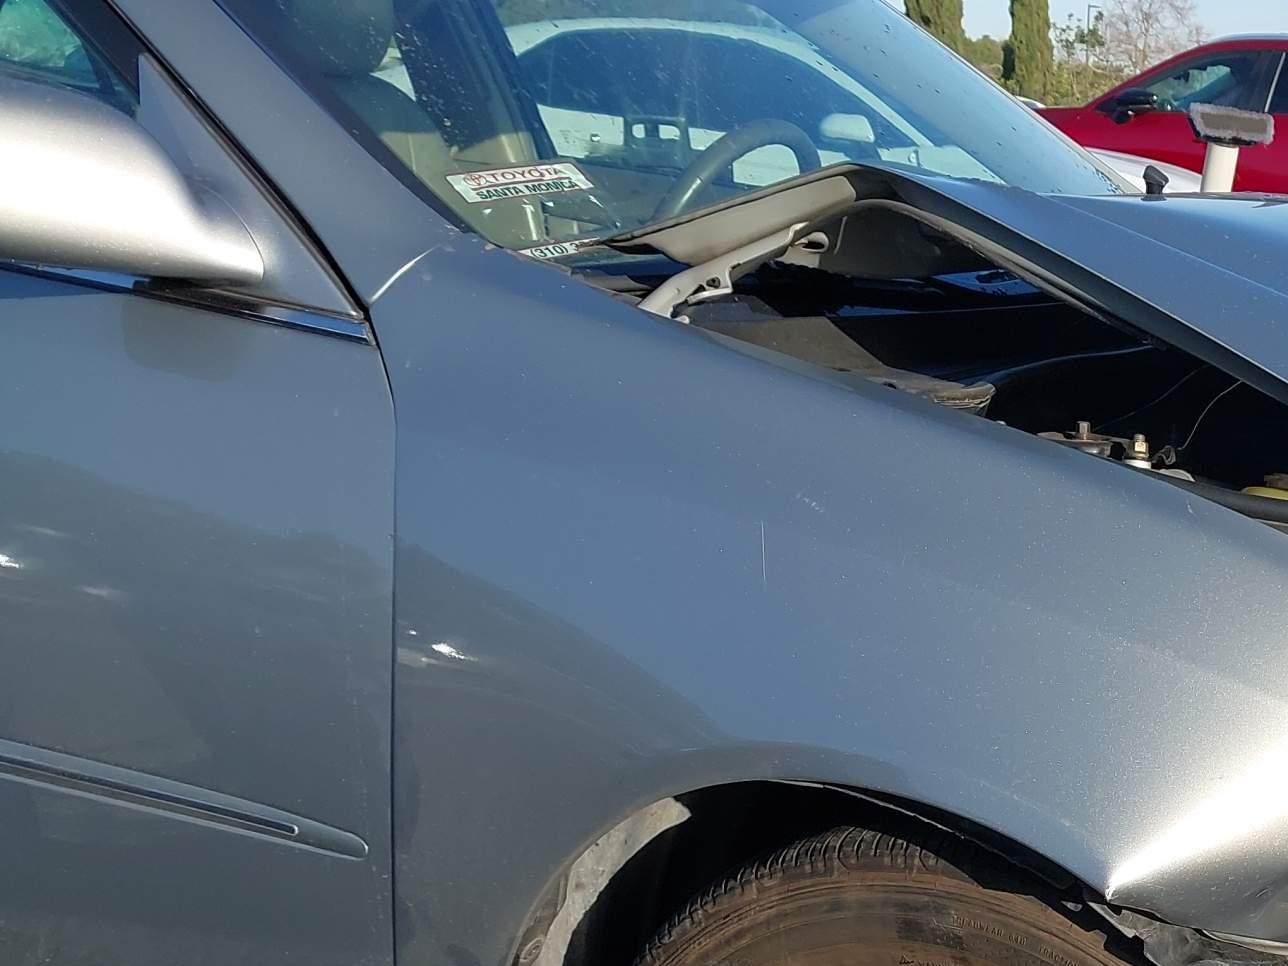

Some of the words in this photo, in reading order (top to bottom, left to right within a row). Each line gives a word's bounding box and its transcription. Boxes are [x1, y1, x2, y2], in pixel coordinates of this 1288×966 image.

[485, 166, 566, 183] TOYOTA
[476, 185, 524, 200] SANTA
[525, 180, 580, 195] MONICA
[530, 244, 568, 257] (310)
